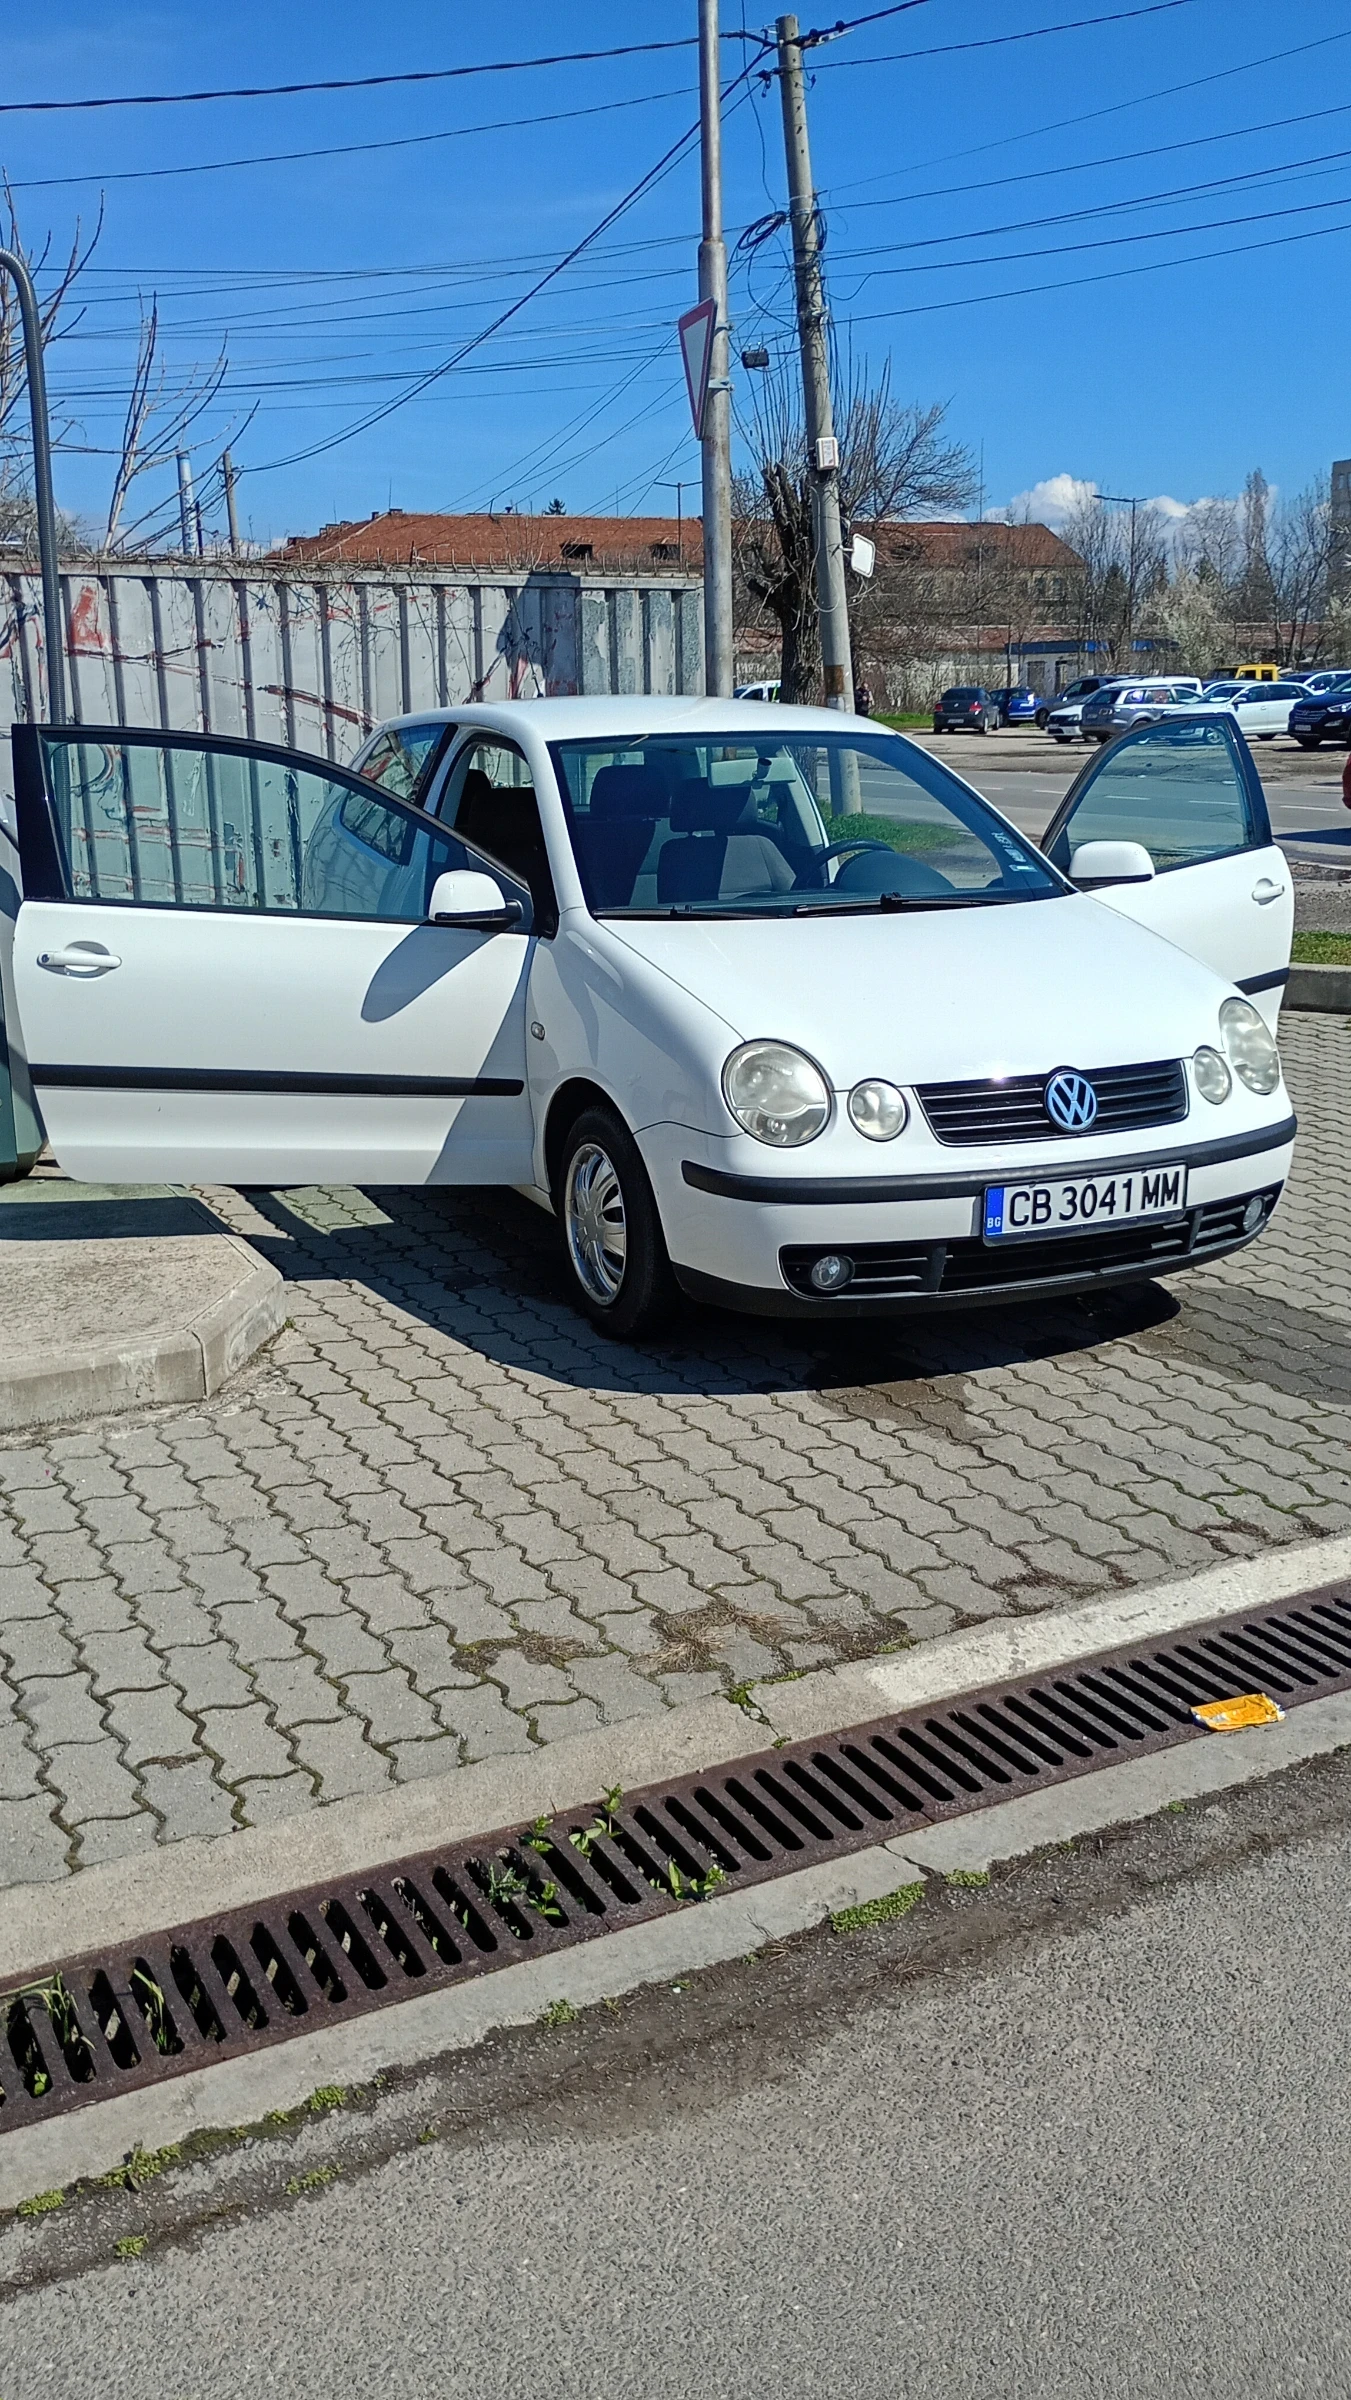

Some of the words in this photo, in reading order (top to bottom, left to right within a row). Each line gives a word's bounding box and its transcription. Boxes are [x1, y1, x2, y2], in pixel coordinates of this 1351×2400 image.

[1048, 1073, 1096, 1130] VW
[986, 1216, 1002, 1229] BG
[1009, 1188, 1052, 1227] CB
[1058, 1177, 1133, 1221] 3041
[1140, 1171, 1180, 1210] MM
